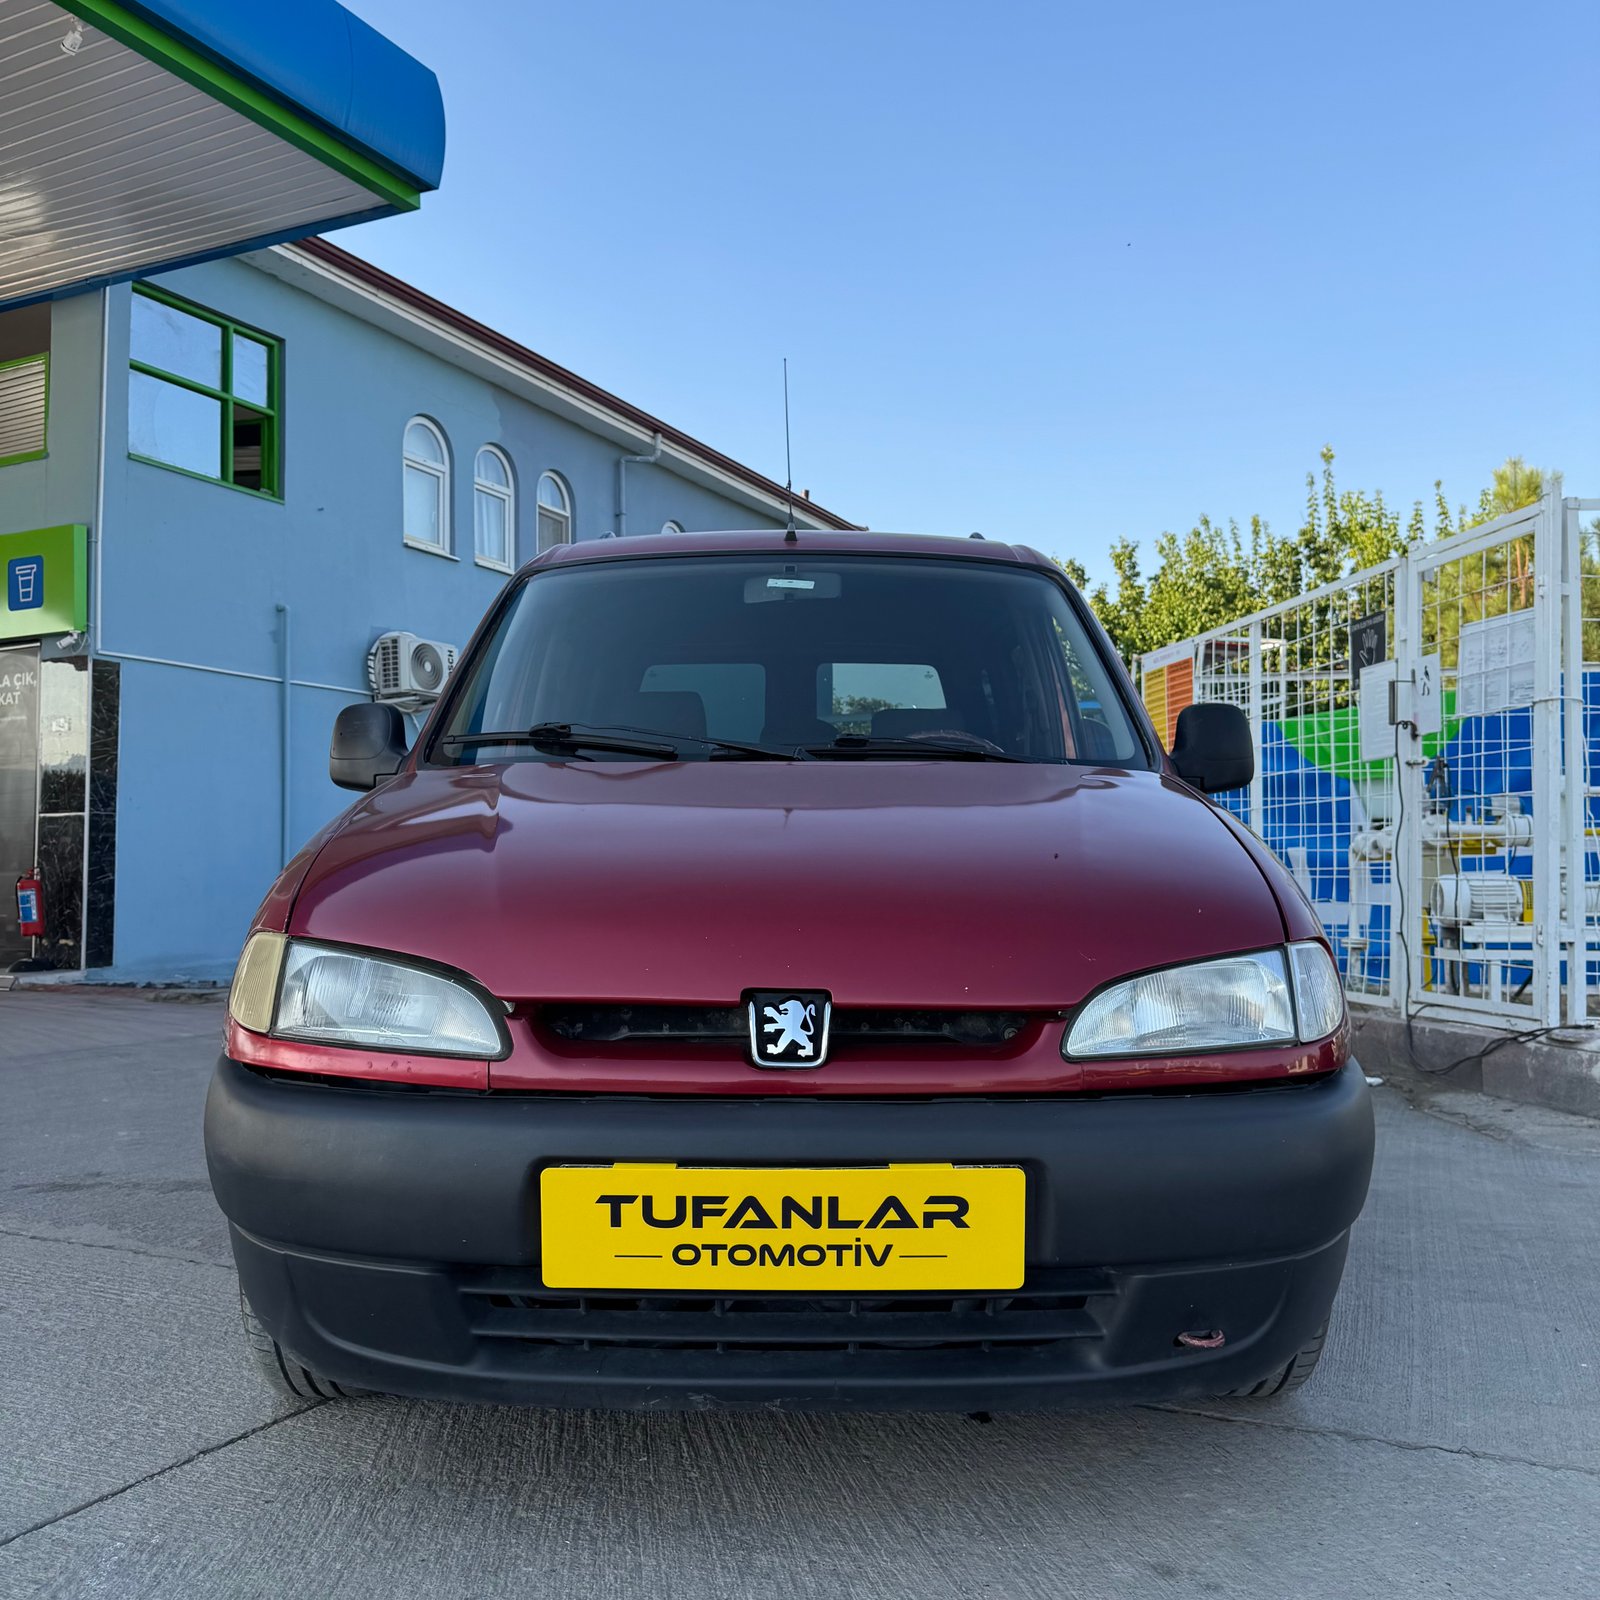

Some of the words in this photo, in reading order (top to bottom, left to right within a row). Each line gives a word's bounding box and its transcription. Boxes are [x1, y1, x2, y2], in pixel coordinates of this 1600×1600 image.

[13, 672, 36, 690] ÇIK,
[595, 1194, 971, 1230] TUFANLAR
[671, 1236, 894, 1267] OTOMOTİV
